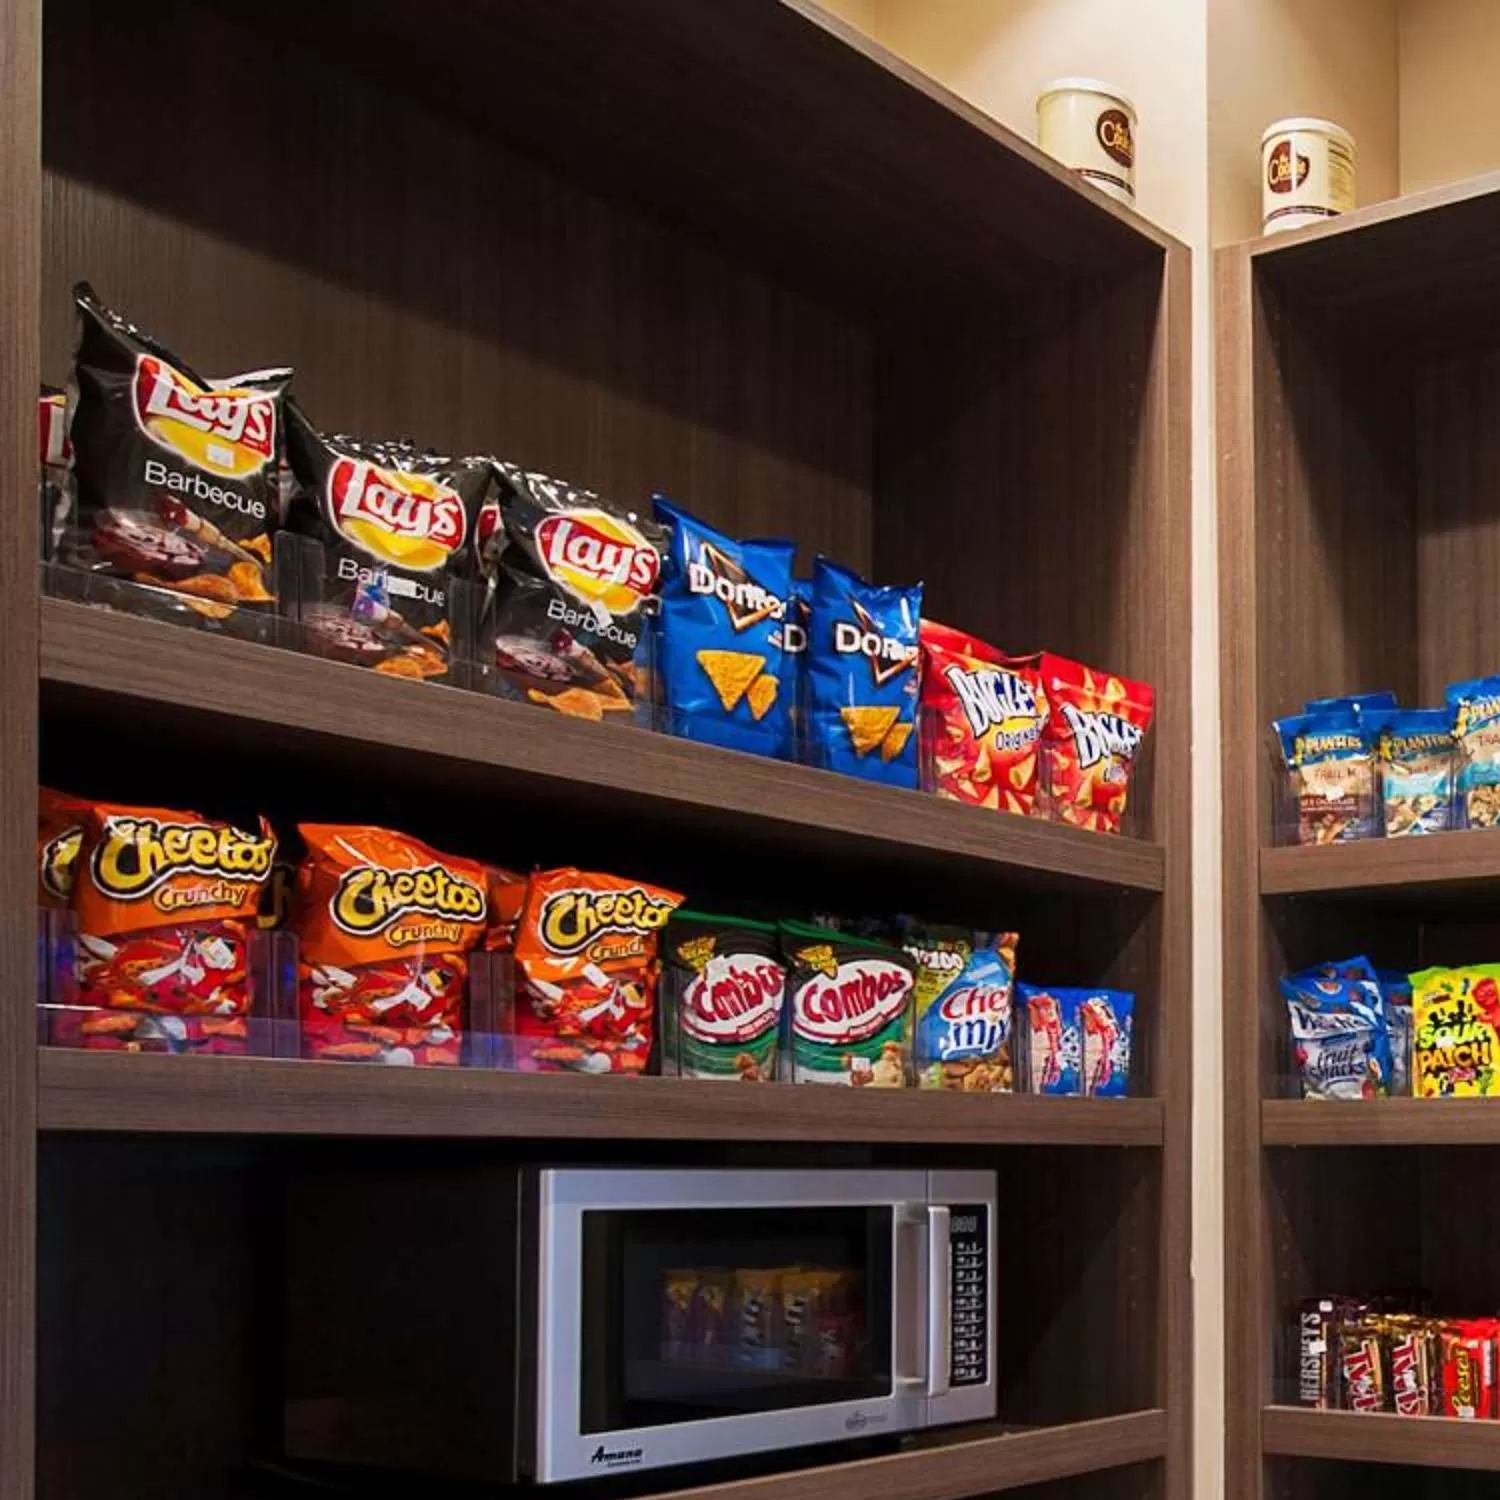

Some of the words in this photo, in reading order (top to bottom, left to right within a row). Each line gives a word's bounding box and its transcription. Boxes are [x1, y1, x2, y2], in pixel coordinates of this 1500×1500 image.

[144, 461, 265, 519] Barbecue
[337, 559, 445, 606] Barcue
[98, 818, 273, 890] Cheetos
[154, 881, 249, 911] Crunchy
[336, 867, 482, 928] Cheetos
[385, 920, 464, 946] Crunchy
[802, 968, 906, 1023] Combos
[942, 987, 1009, 1019] Che
[1418, 1020, 1487, 1049] SOUR
[1419, 1042, 1493, 1074] PATCH
